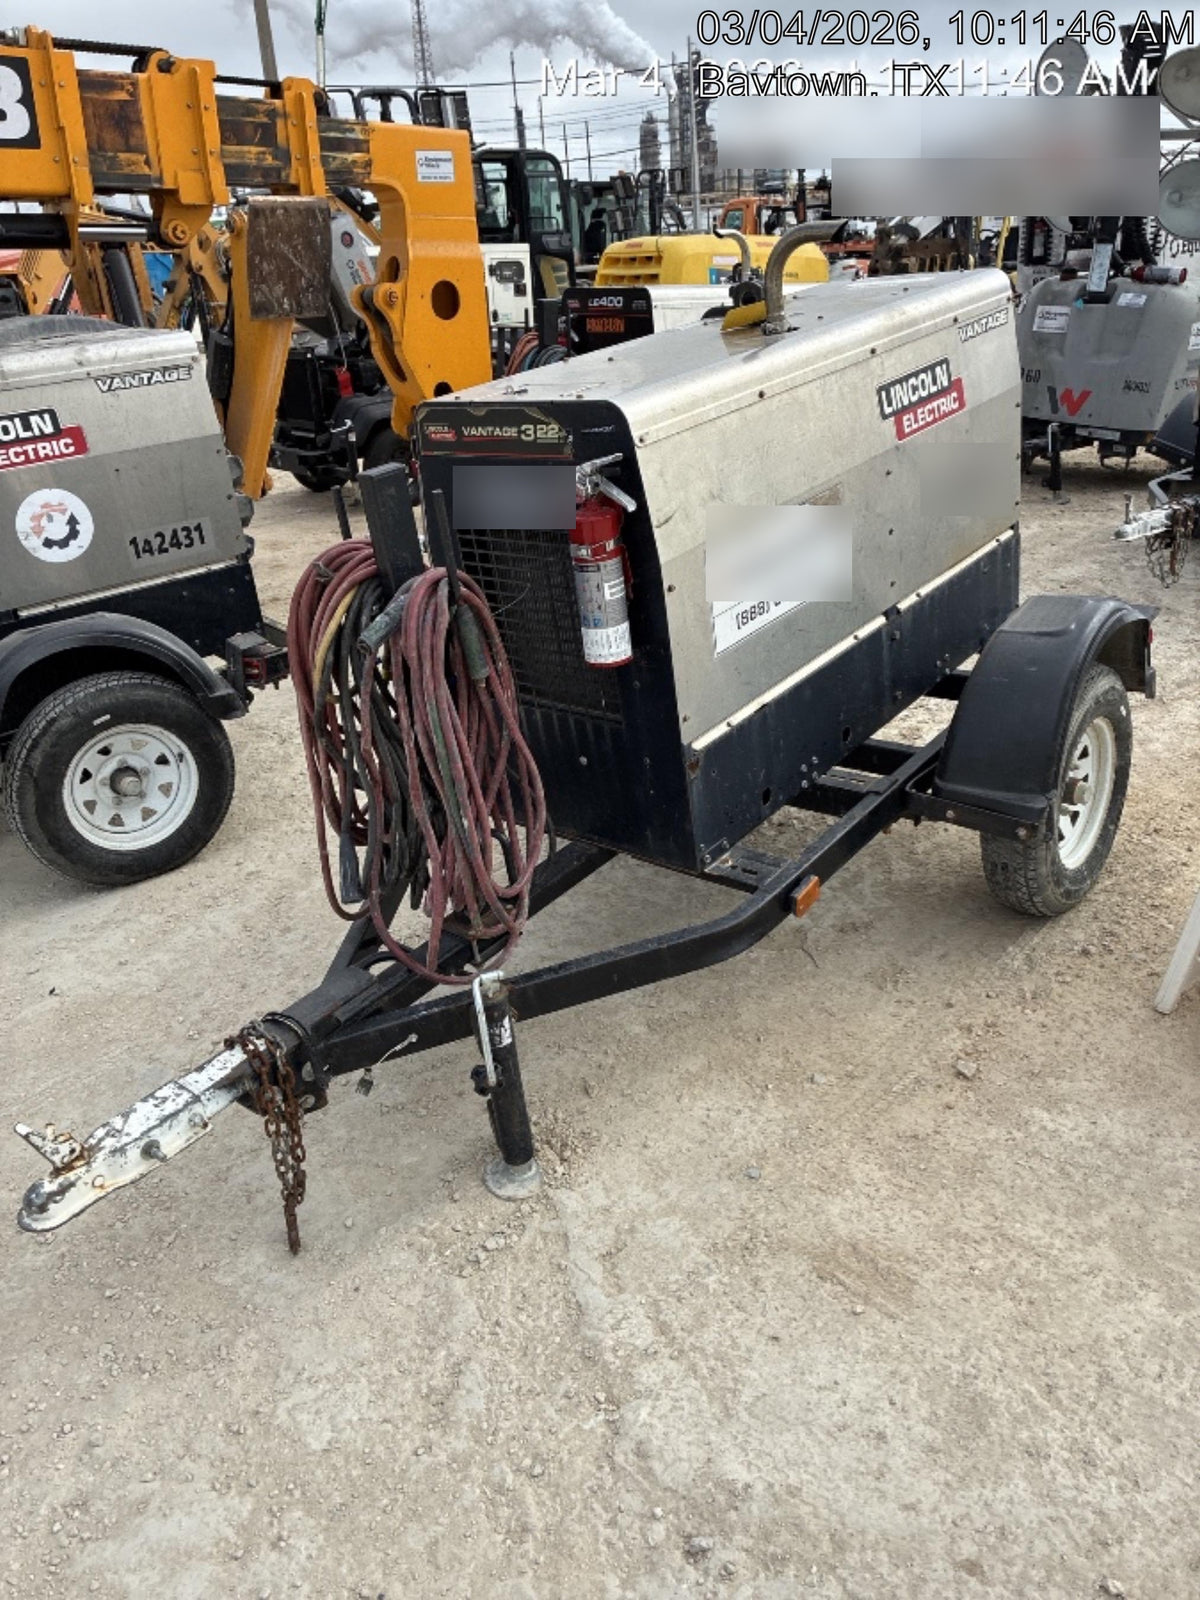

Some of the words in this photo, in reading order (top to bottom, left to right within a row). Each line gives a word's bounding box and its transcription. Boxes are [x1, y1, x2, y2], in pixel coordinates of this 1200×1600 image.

[958, 308, 1009, 343] VANTAGE
[96, 366, 194, 393] VANTAGE
[880, 362, 950, 416] LINCOLN
[902, 391, 960, 434] ELECTRIC
[461, 425, 518, 437] VANTAGE
[520, 424, 560, 441] 322
[128, 522, 206, 560] 142431
